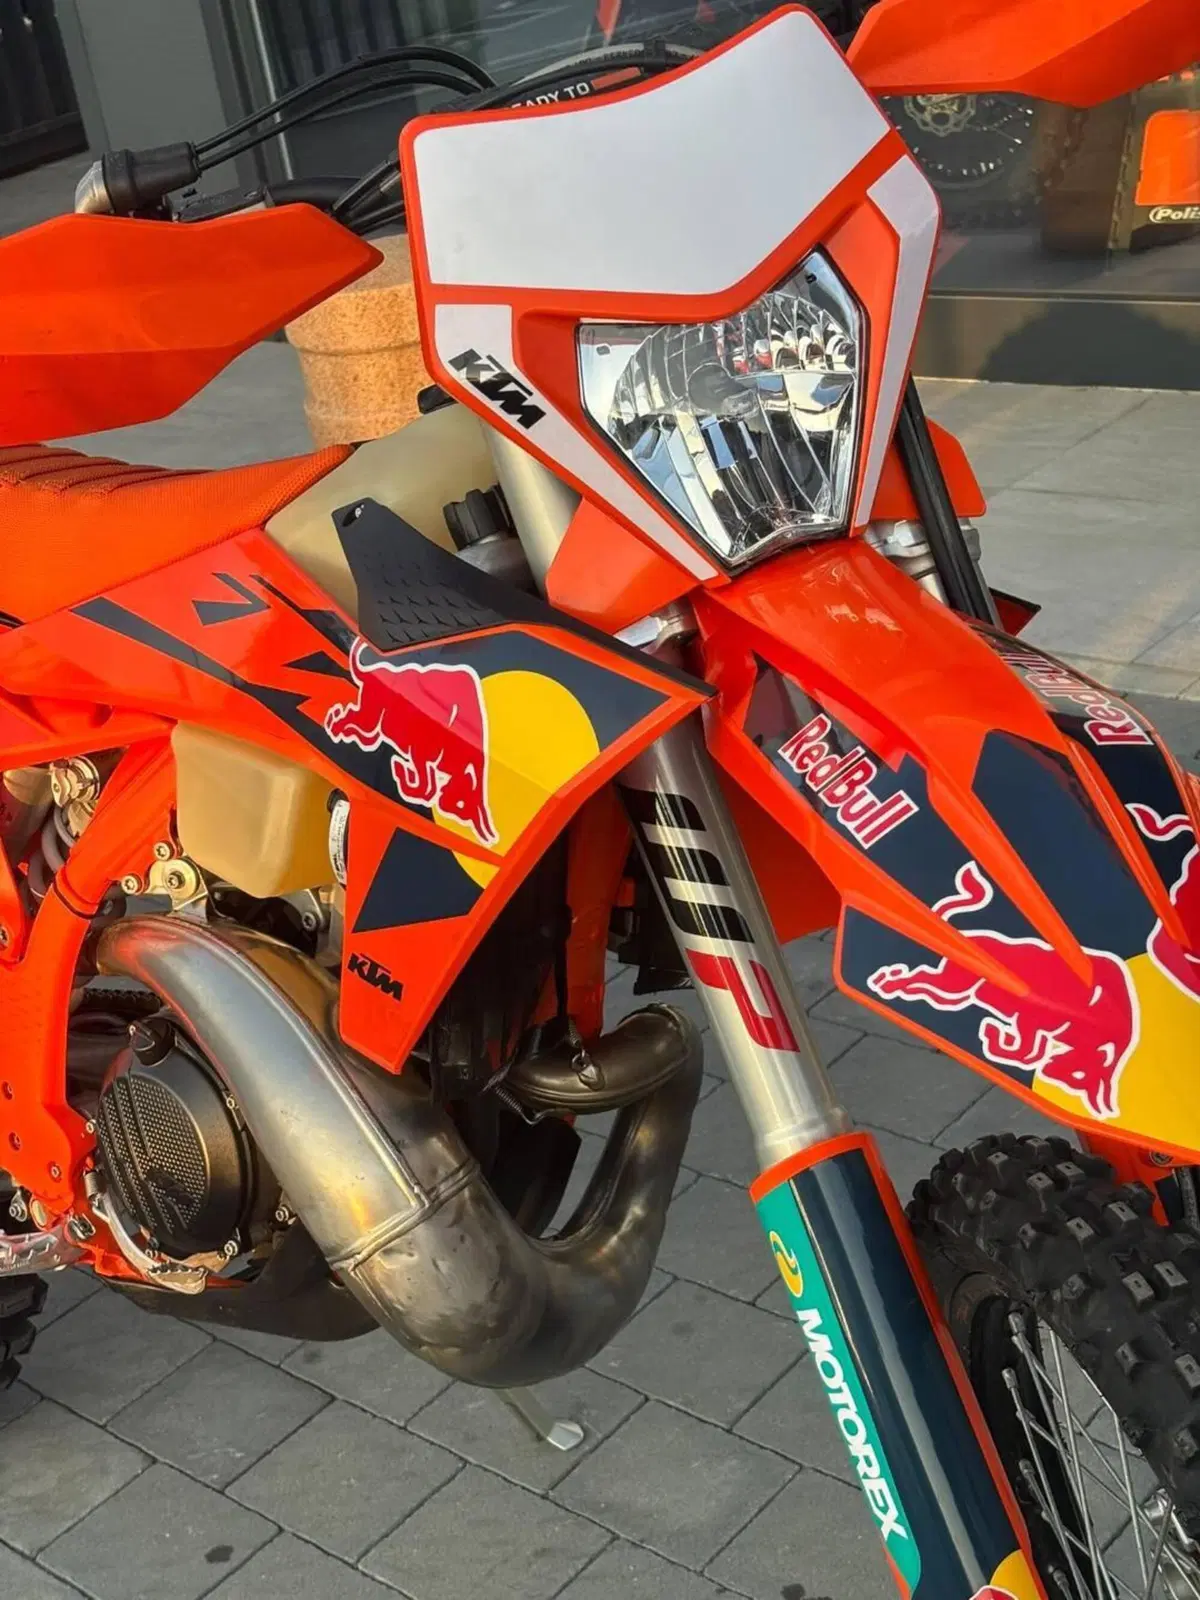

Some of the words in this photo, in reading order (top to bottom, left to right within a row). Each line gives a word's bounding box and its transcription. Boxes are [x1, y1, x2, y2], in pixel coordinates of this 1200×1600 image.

[563, 81, 590, 99] TO
[447, 348, 547, 430] KTM
[347, 953, 404, 1002] KTM
[796, 1307, 909, 1542] MOTOREX
